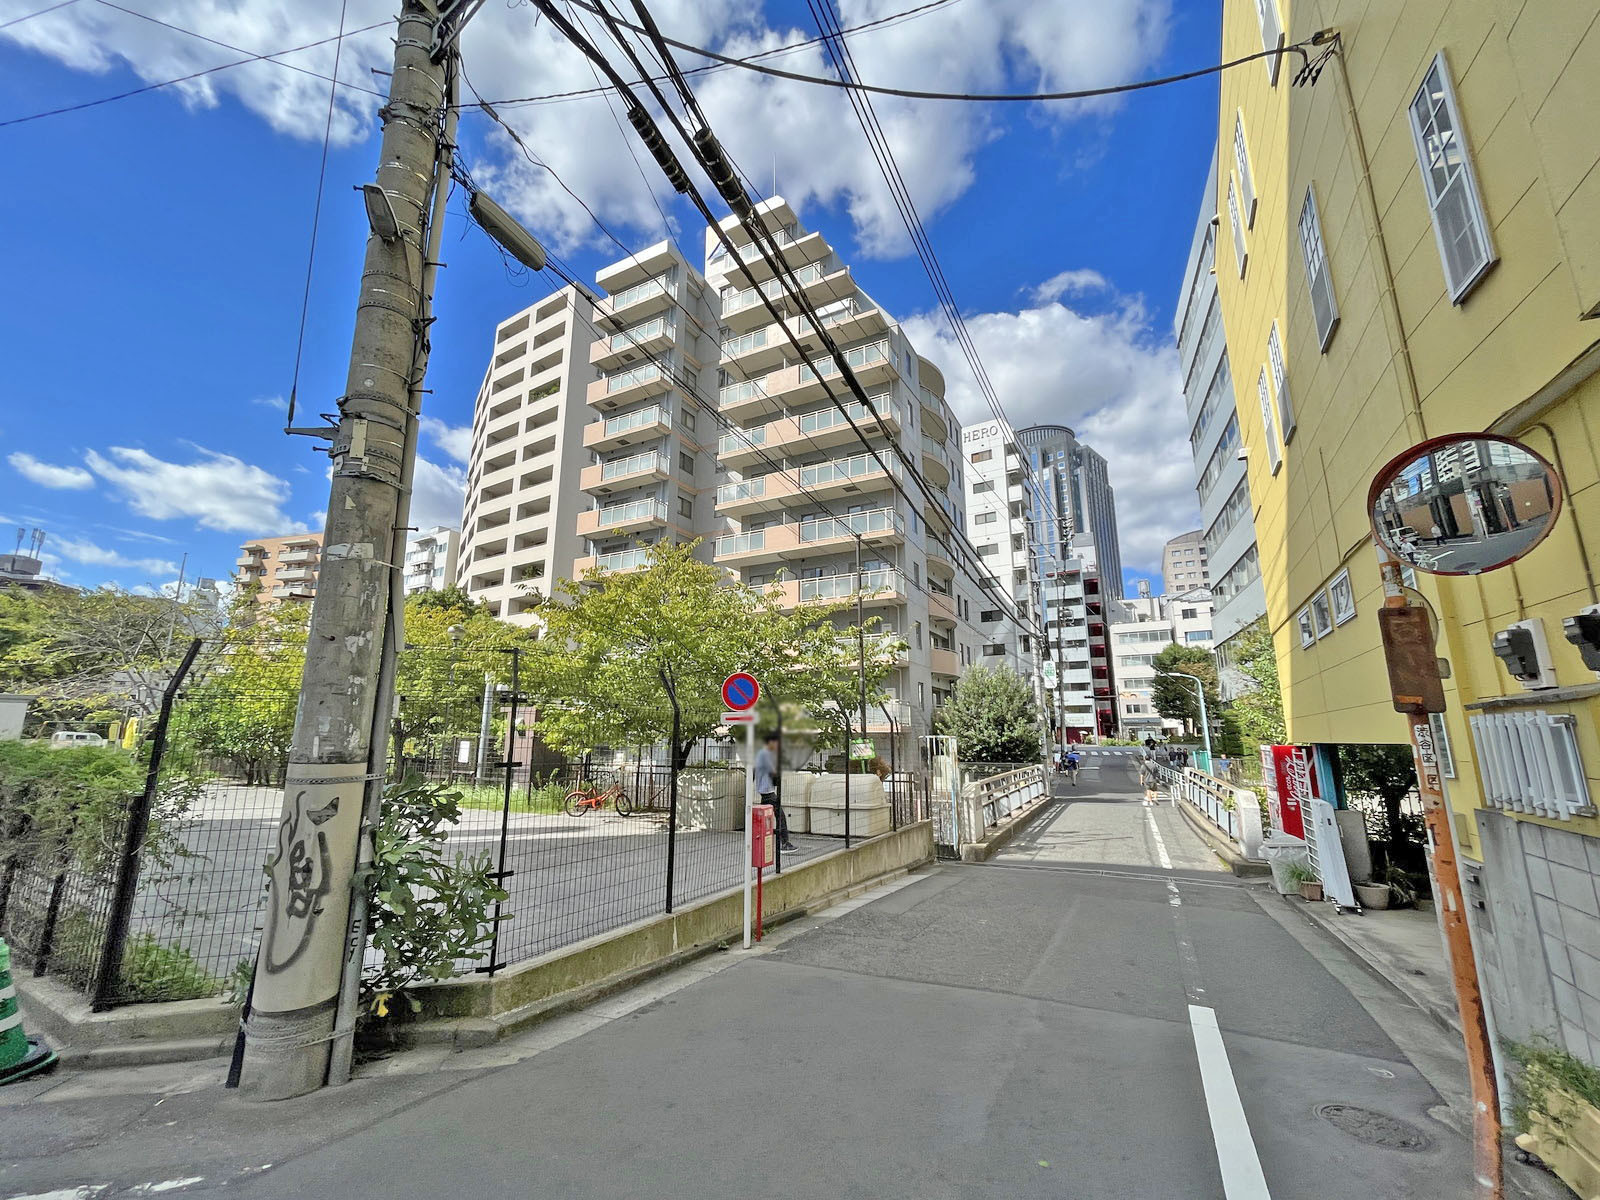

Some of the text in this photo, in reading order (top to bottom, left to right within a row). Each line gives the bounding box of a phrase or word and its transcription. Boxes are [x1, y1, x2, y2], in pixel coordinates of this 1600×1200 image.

[963, 425, 998, 443] HERO
[1416, 724, 1435, 763] 渋谷区
